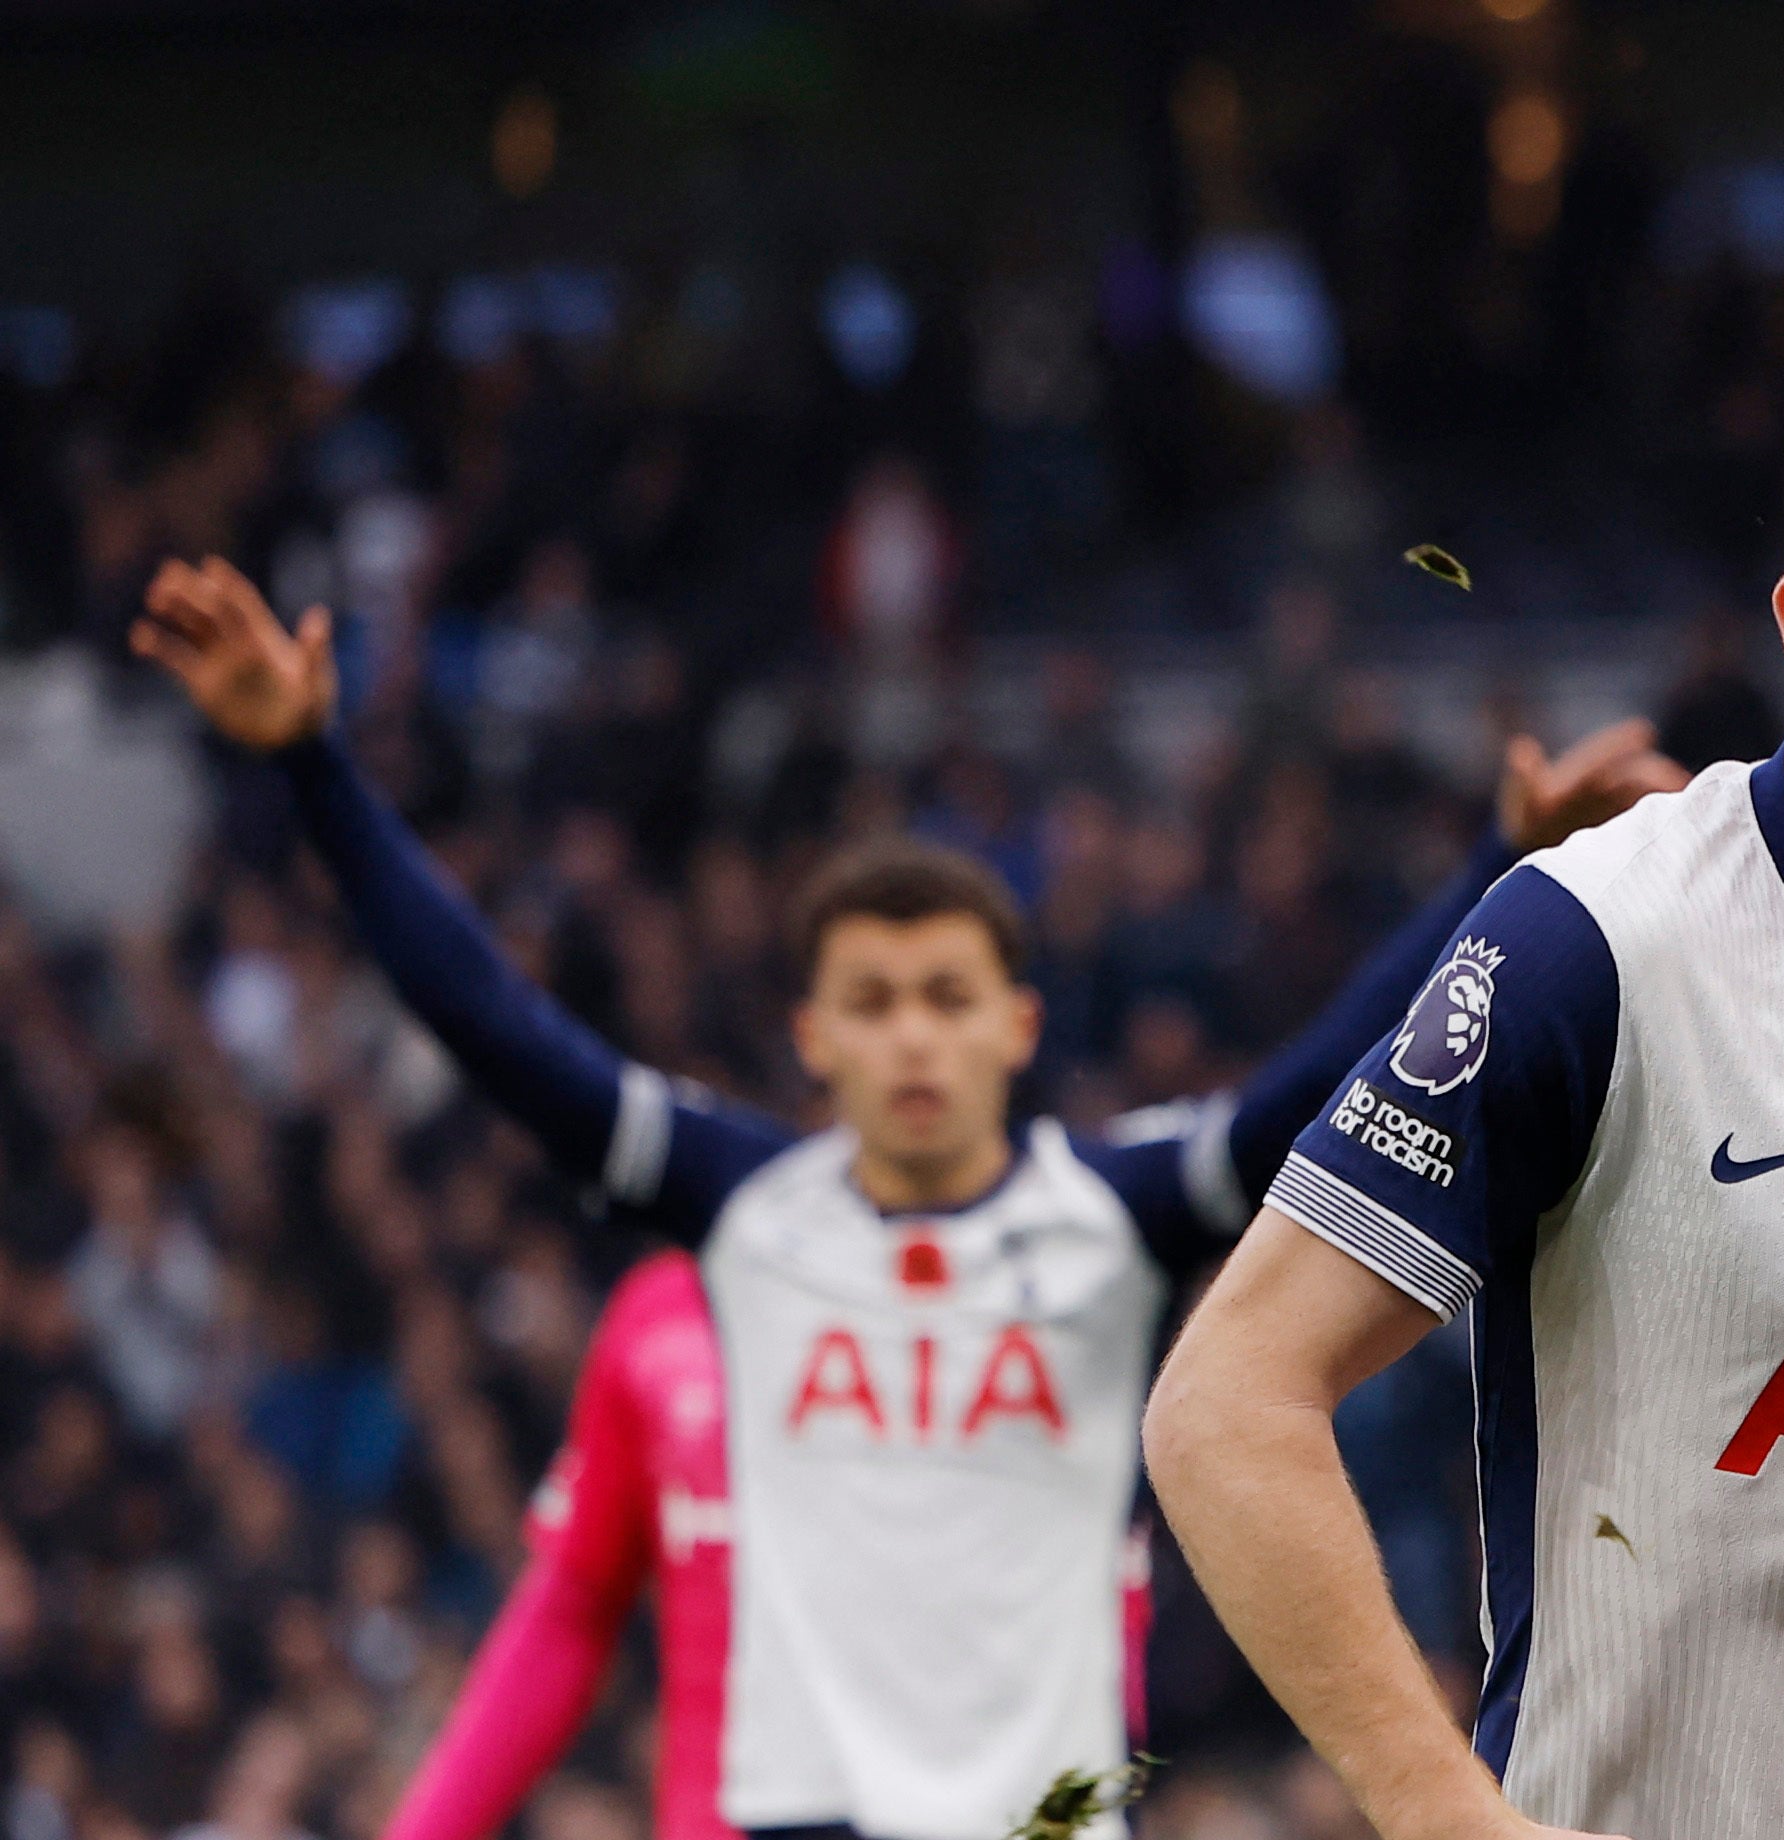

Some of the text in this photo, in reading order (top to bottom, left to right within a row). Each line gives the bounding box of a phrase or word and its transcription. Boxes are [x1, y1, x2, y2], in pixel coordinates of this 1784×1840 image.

[1329, 1106, 1455, 1188] for racism
[1342, 1077, 1453, 1158] No room
[787, 1325, 1067, 1441] AIA
